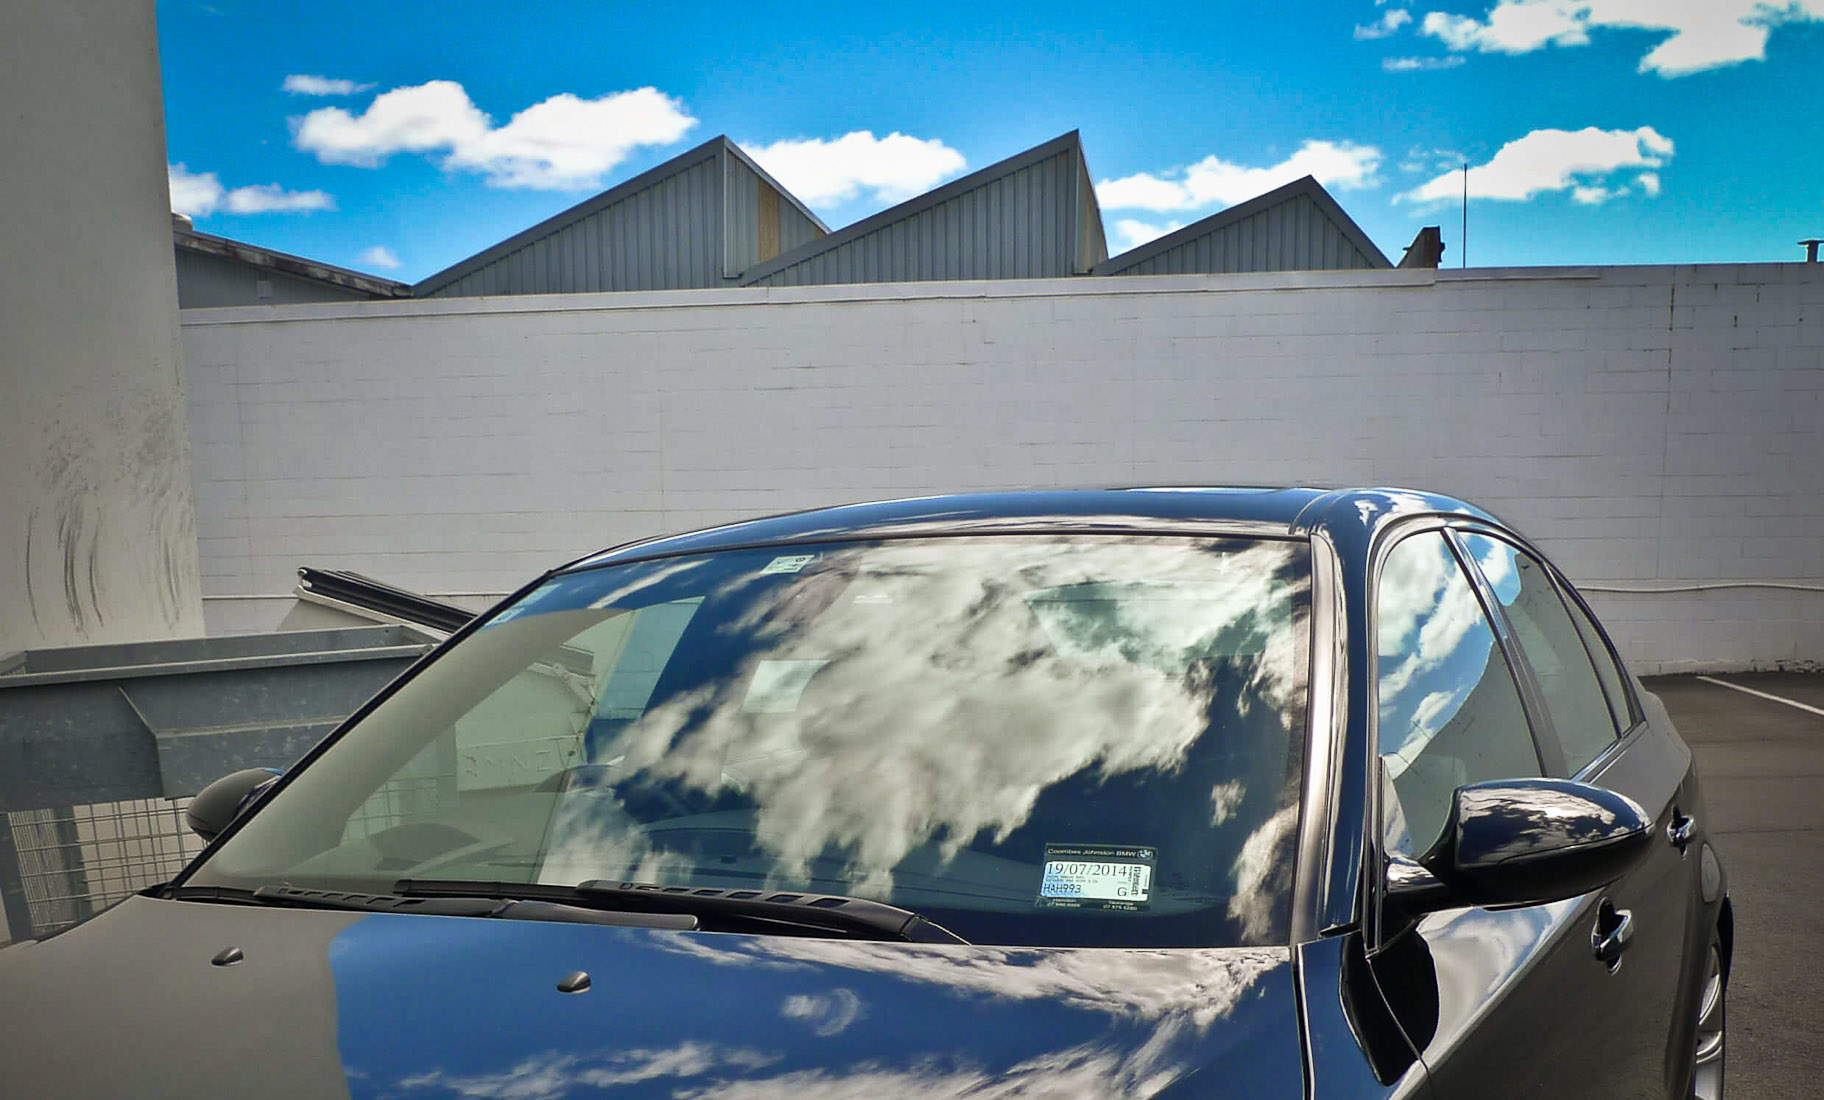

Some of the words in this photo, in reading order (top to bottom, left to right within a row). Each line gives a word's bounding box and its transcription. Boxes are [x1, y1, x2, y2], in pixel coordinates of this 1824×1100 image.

[1047, 863, 1127, 877] 19/07/2014
[1043, 883, 1081, 894] HAH993
[1117, 887, 1127, 897] G
